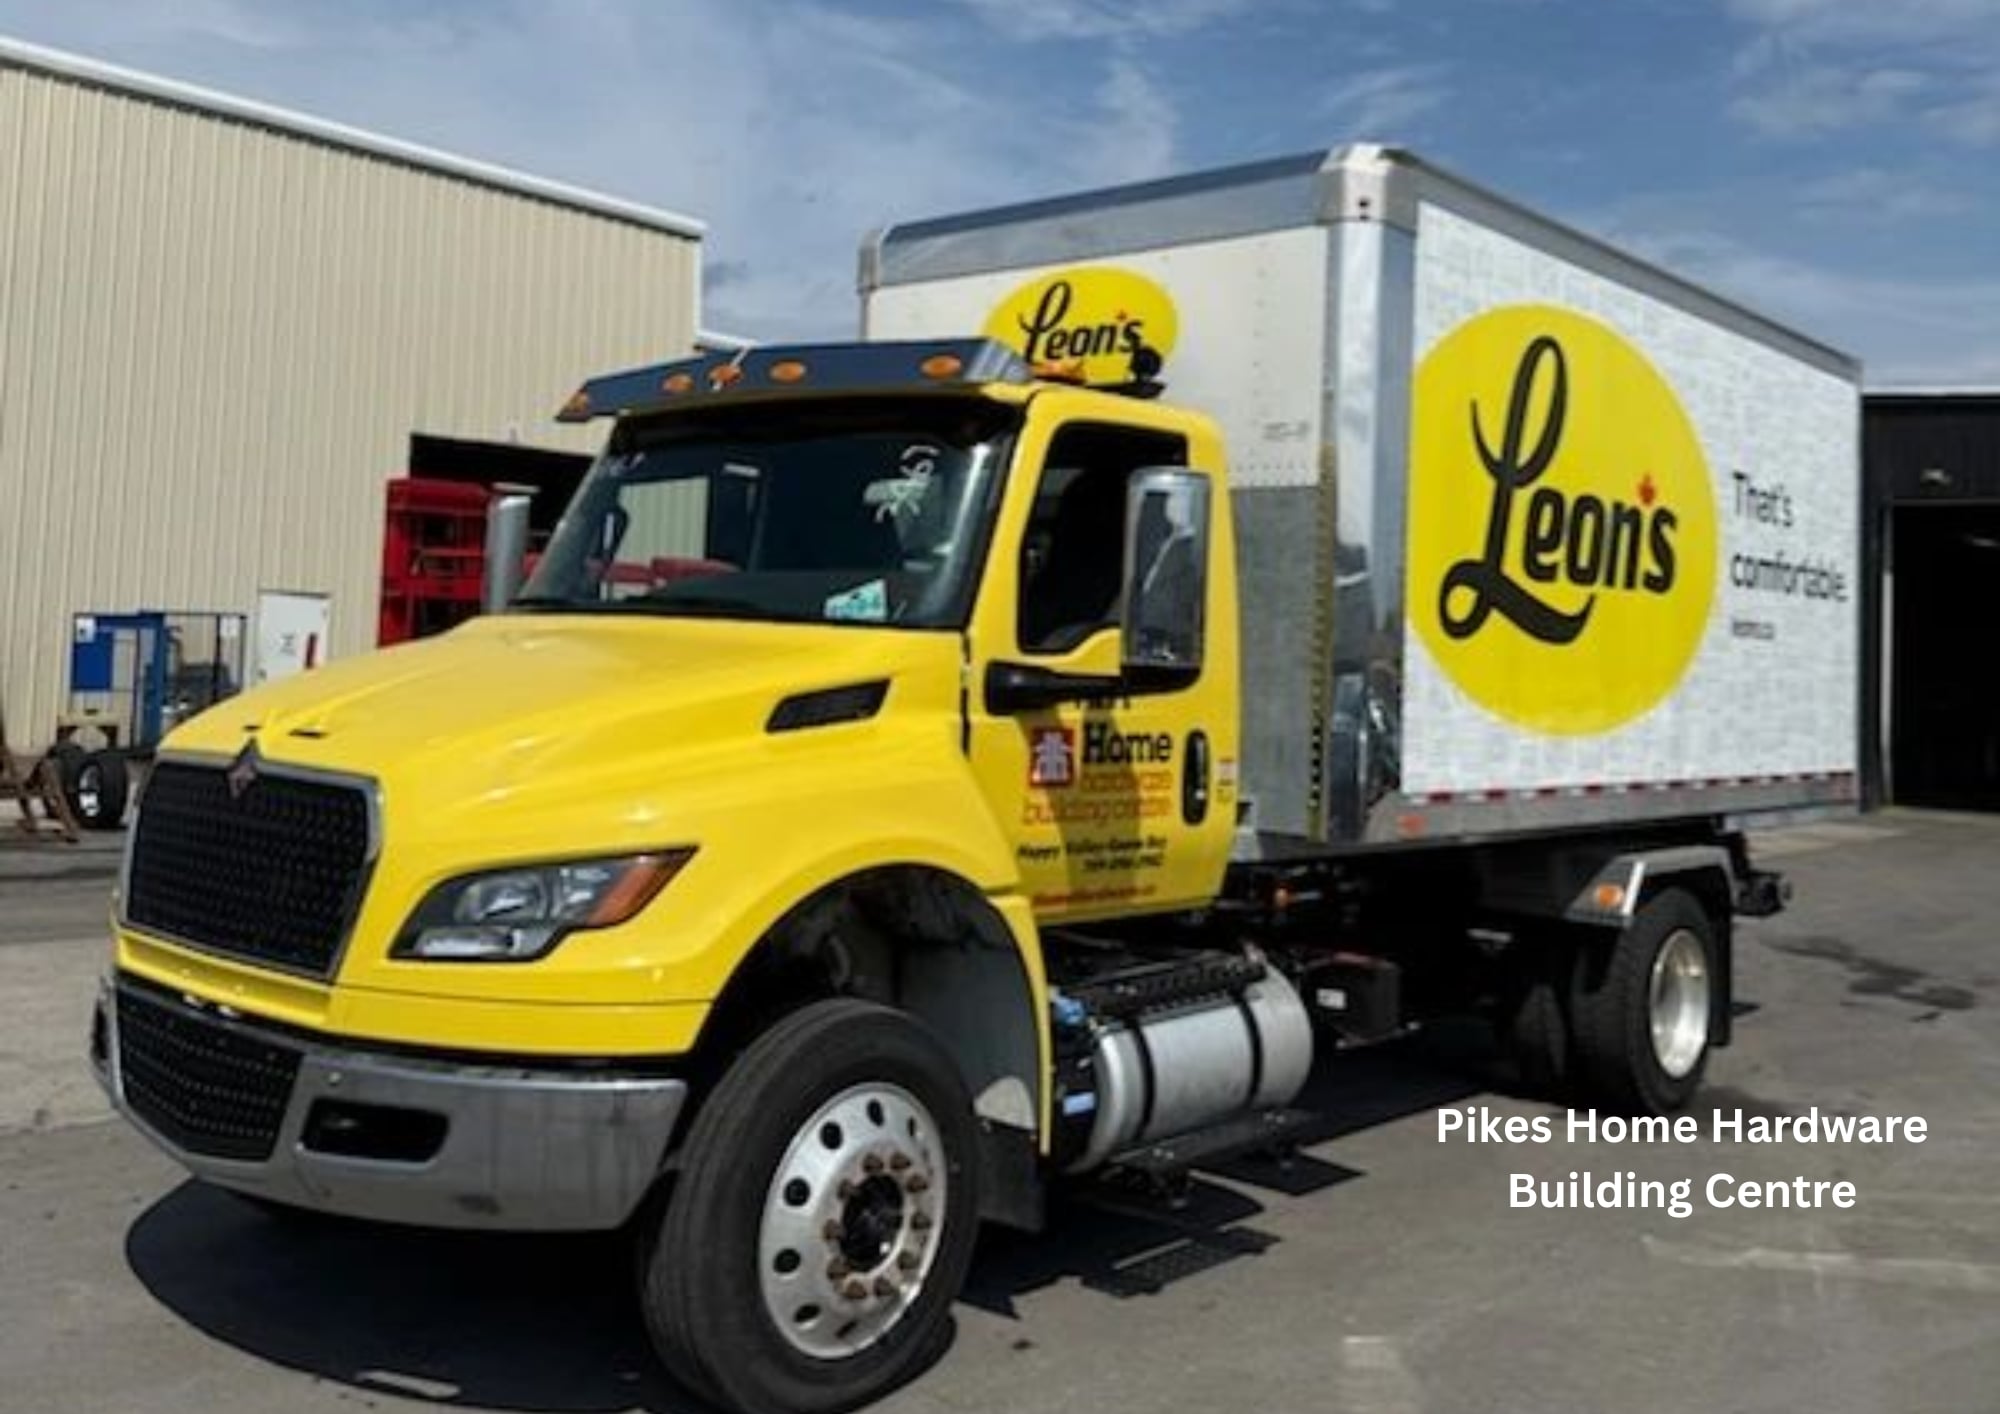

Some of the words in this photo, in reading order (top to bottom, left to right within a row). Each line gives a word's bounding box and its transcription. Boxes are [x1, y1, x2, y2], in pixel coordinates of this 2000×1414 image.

[1017, 281, 1144, 366] Leon's
[1439, 335, 1678, 646] Leon's
[1732, 471, 1793, 527] That's
[1081, 722, 1173, 763] Home
